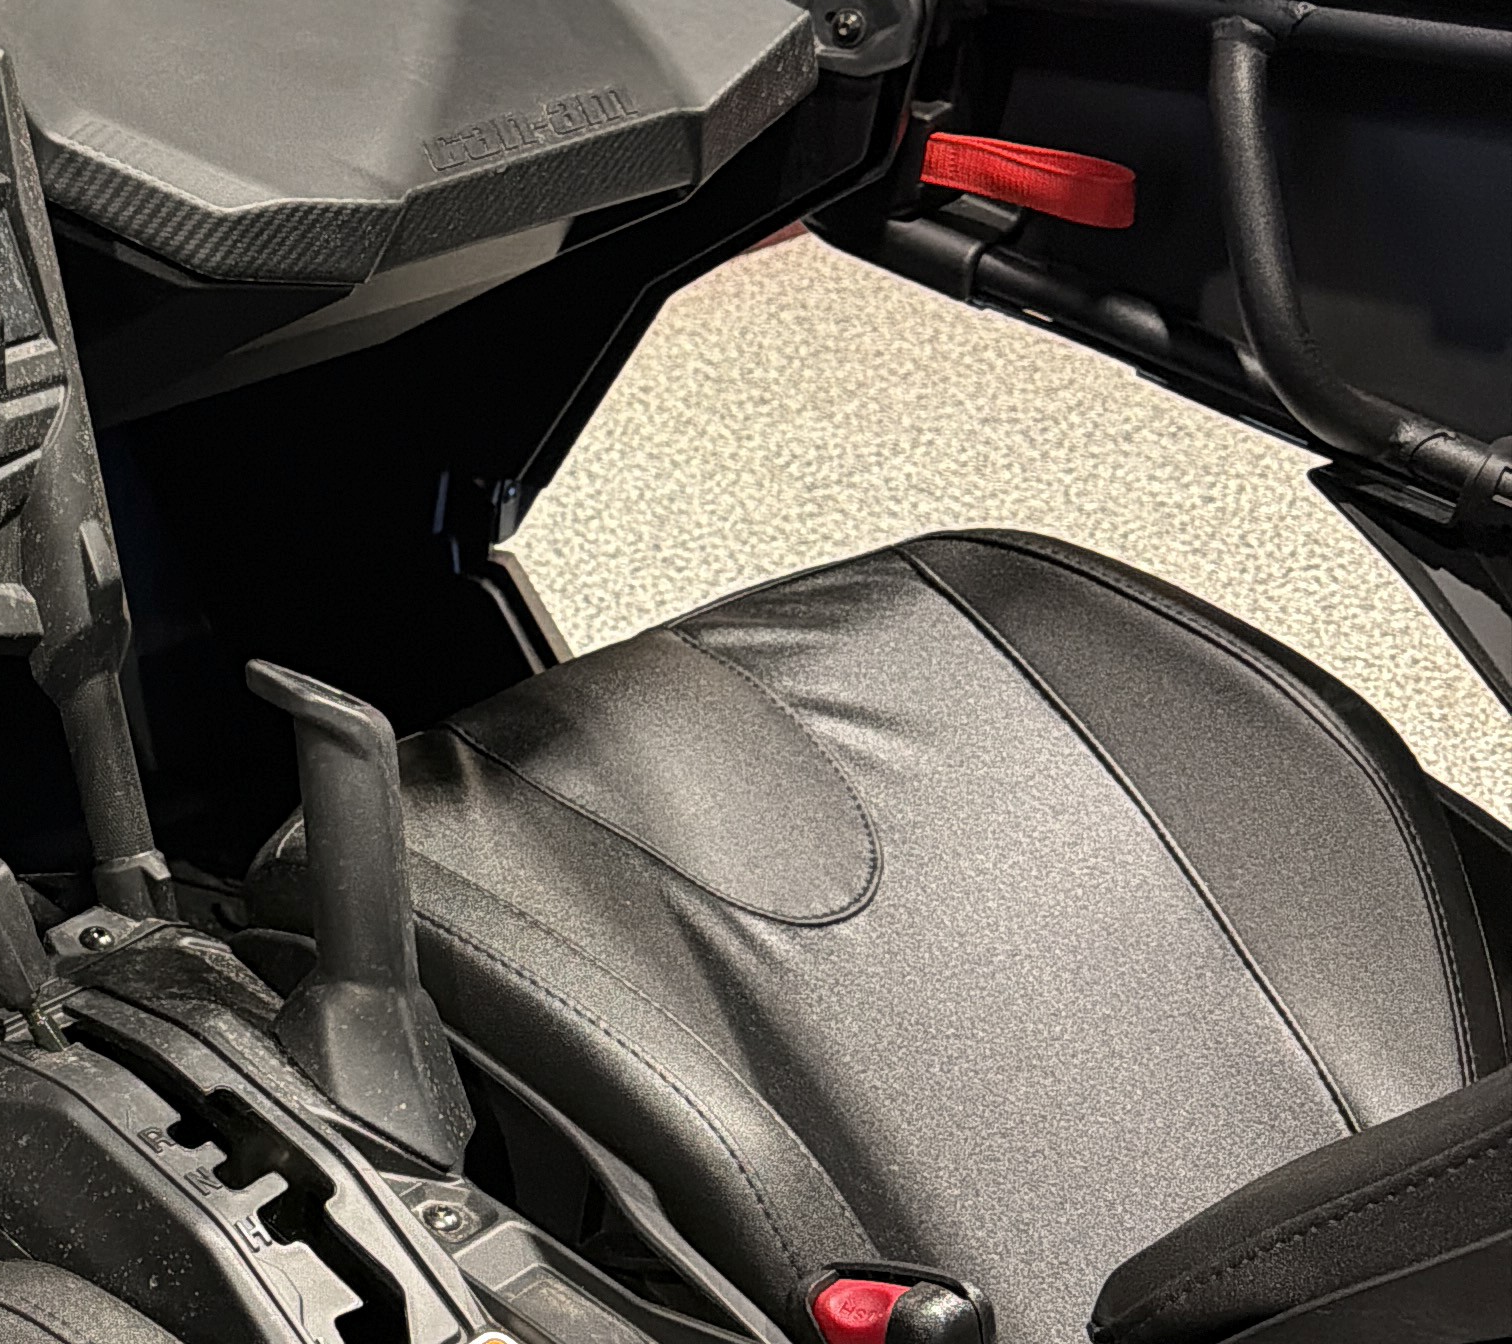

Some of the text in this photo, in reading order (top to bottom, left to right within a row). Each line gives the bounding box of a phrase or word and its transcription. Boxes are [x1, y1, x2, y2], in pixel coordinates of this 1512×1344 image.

[422, 86, 639, 172] can-am
[137, 1127, 176, 1154] R
[184, 1166, 223, 1196] N
[234, 1216, 273, 1253] H
